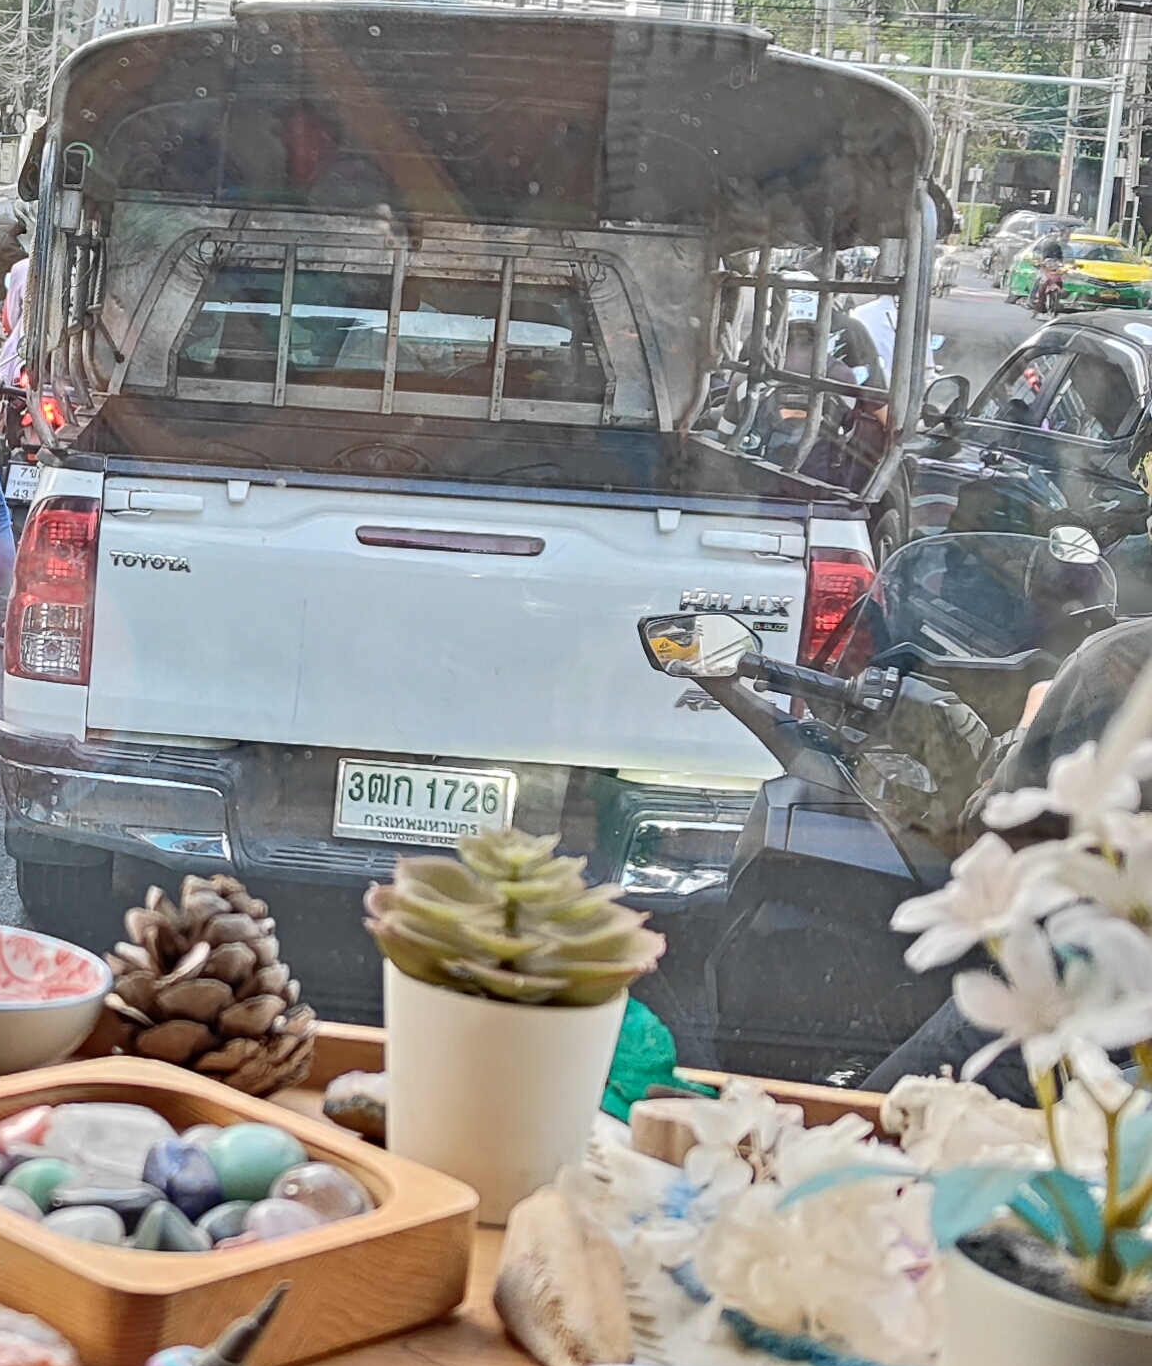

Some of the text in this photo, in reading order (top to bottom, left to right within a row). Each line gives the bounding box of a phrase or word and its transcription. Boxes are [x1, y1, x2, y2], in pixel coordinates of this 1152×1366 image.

[110, 550, 191, 573] TOYOTA
[679, 590, 796, 618] HILUX
[426, 777, 500, 815] 1726
[364, 813, 480, 836] กรุงเทพมหานคร
